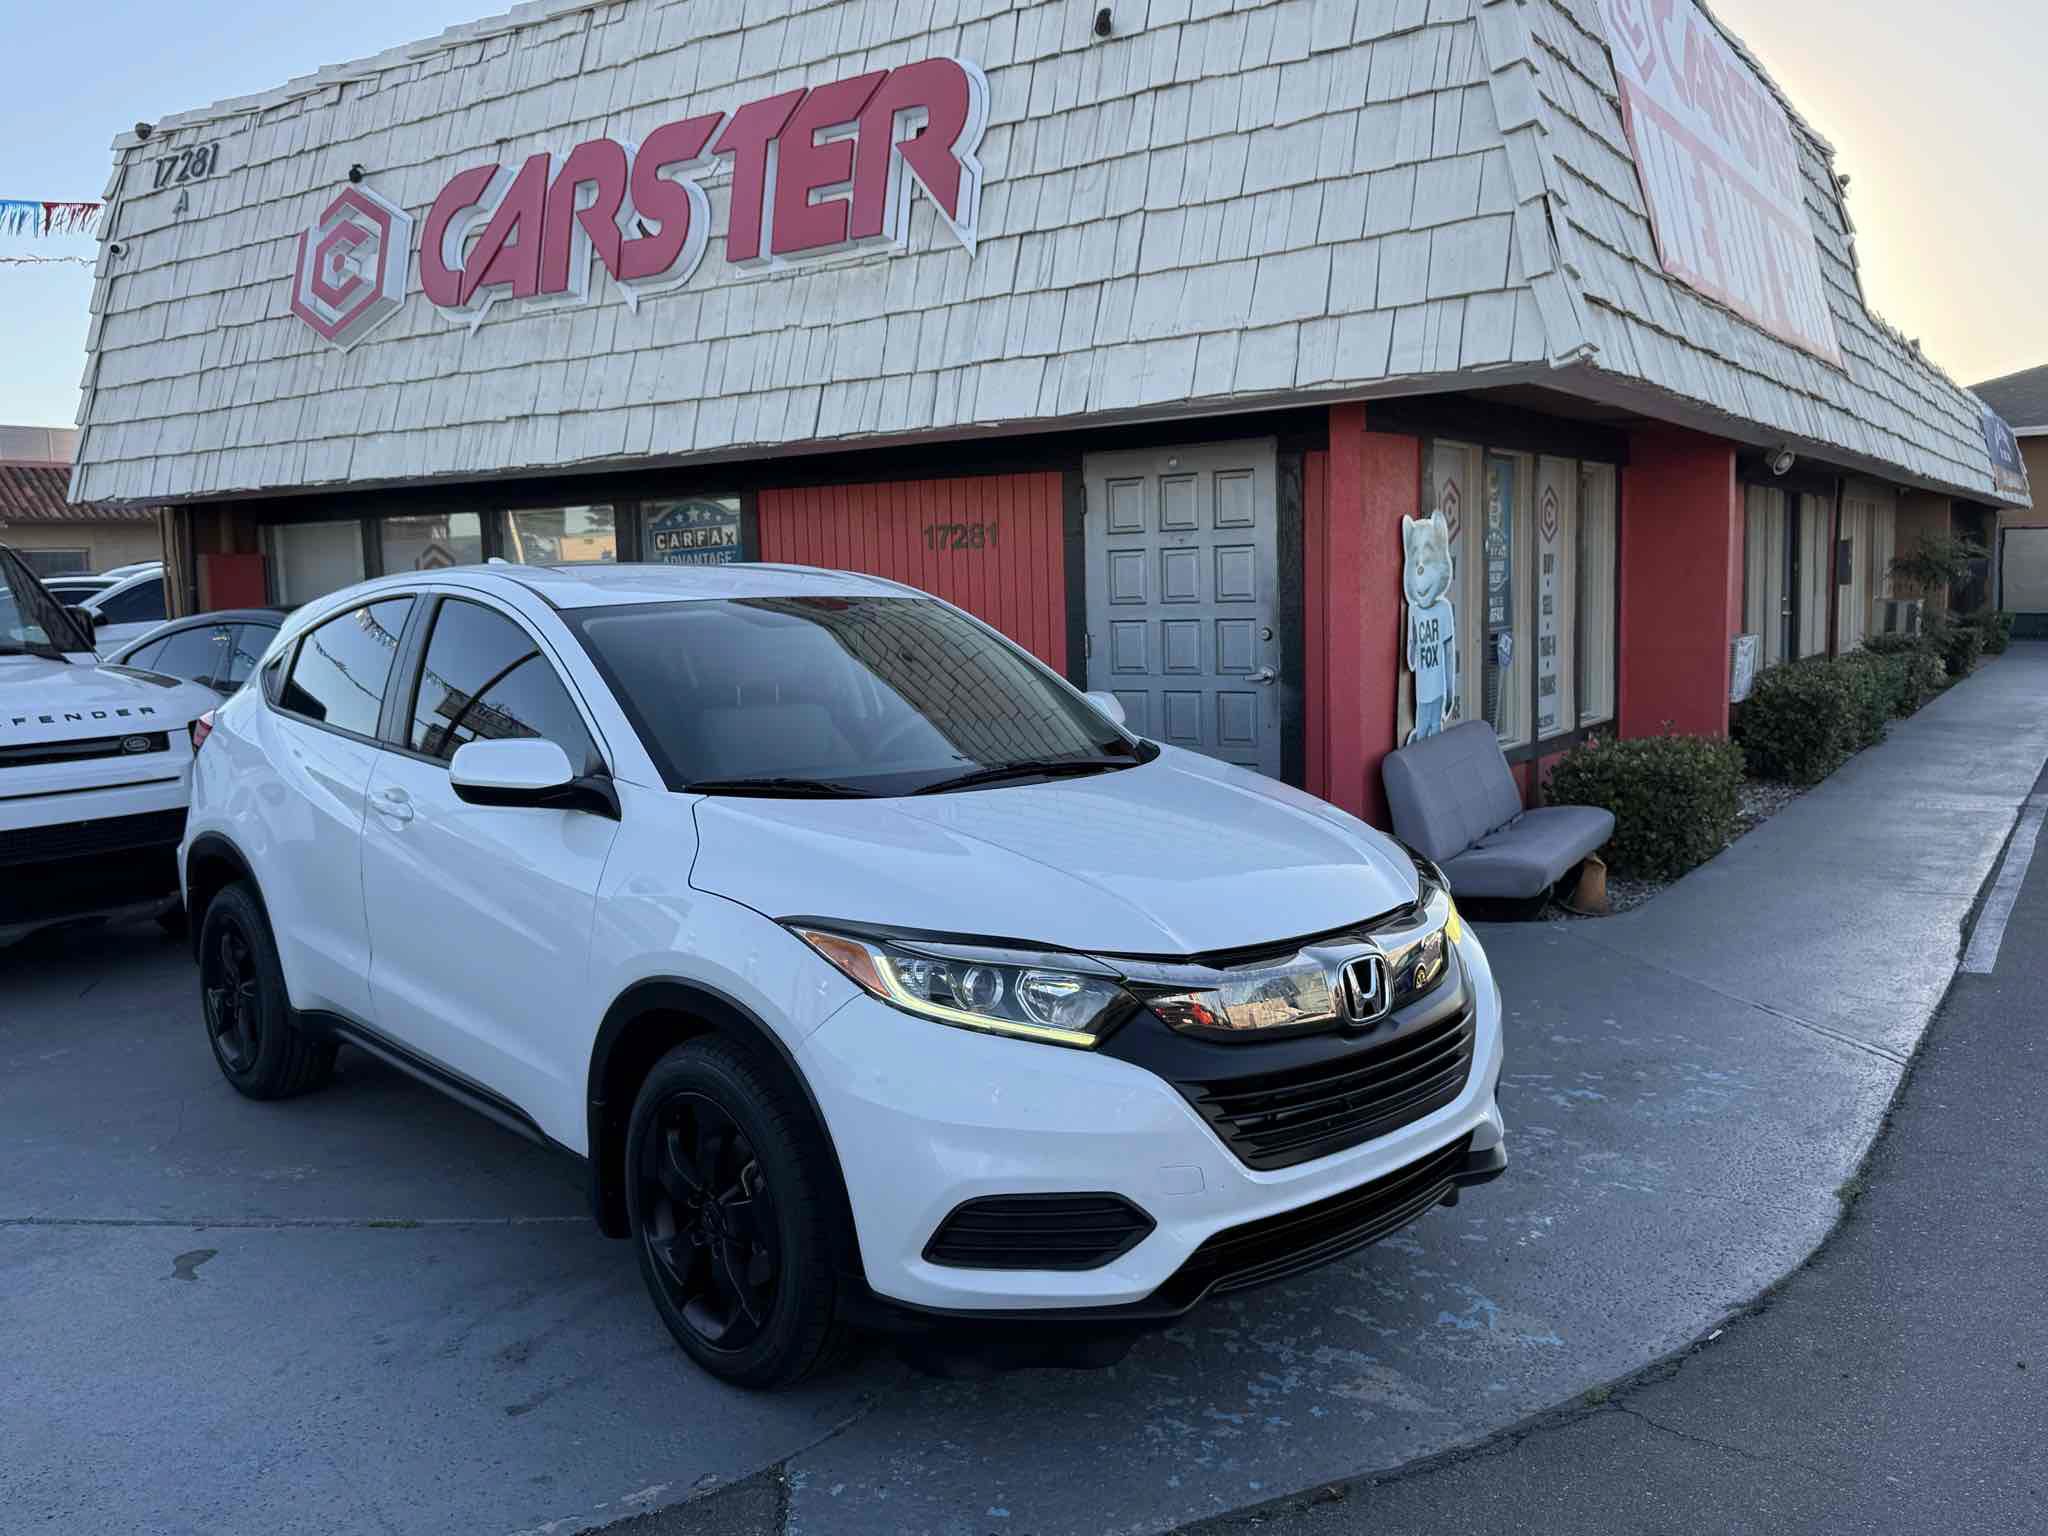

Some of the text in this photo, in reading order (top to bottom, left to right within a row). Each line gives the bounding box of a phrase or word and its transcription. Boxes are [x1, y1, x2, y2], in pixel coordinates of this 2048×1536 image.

[153, 142, 219, 189] 17281
[419, 57, 975, 309] CARSTER
[656, 526, 736, 550] CARFAX
[924, 521, 997, 550] 17281
[1419, 618, 1439, 644] CAR
[1420, 643, 1439, 669] FOX
[0, 706, 156, 728] FENDER
